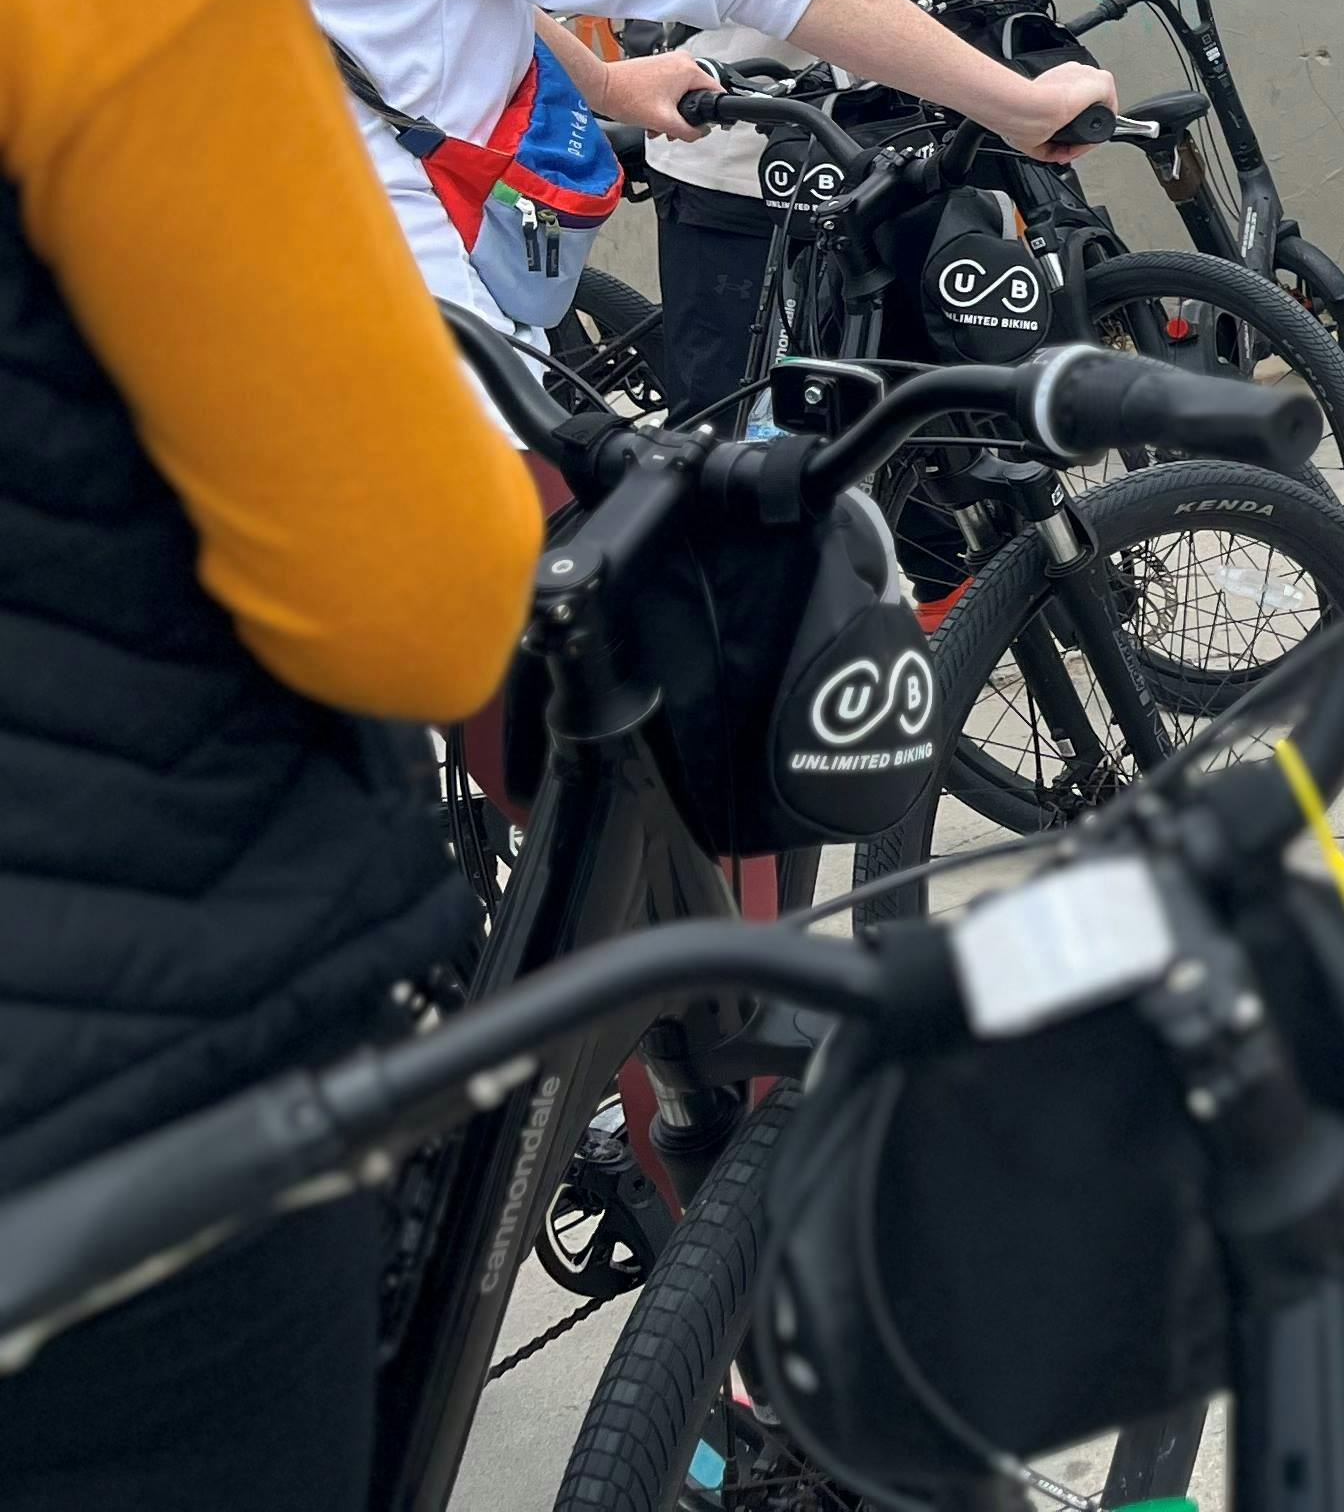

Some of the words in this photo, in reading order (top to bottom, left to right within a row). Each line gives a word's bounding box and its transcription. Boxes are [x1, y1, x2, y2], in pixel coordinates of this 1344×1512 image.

[944, 310, 999, 327] NLIMITED
[1001, 318, 1038, 331] BIKING
[1174, 499, 1274, 517] KENDA
[791, 753, 891, 770] UNLIMITED
[894, 742, 933, 766] BIKING
[481, 1075, 561, 1294] cannondale
